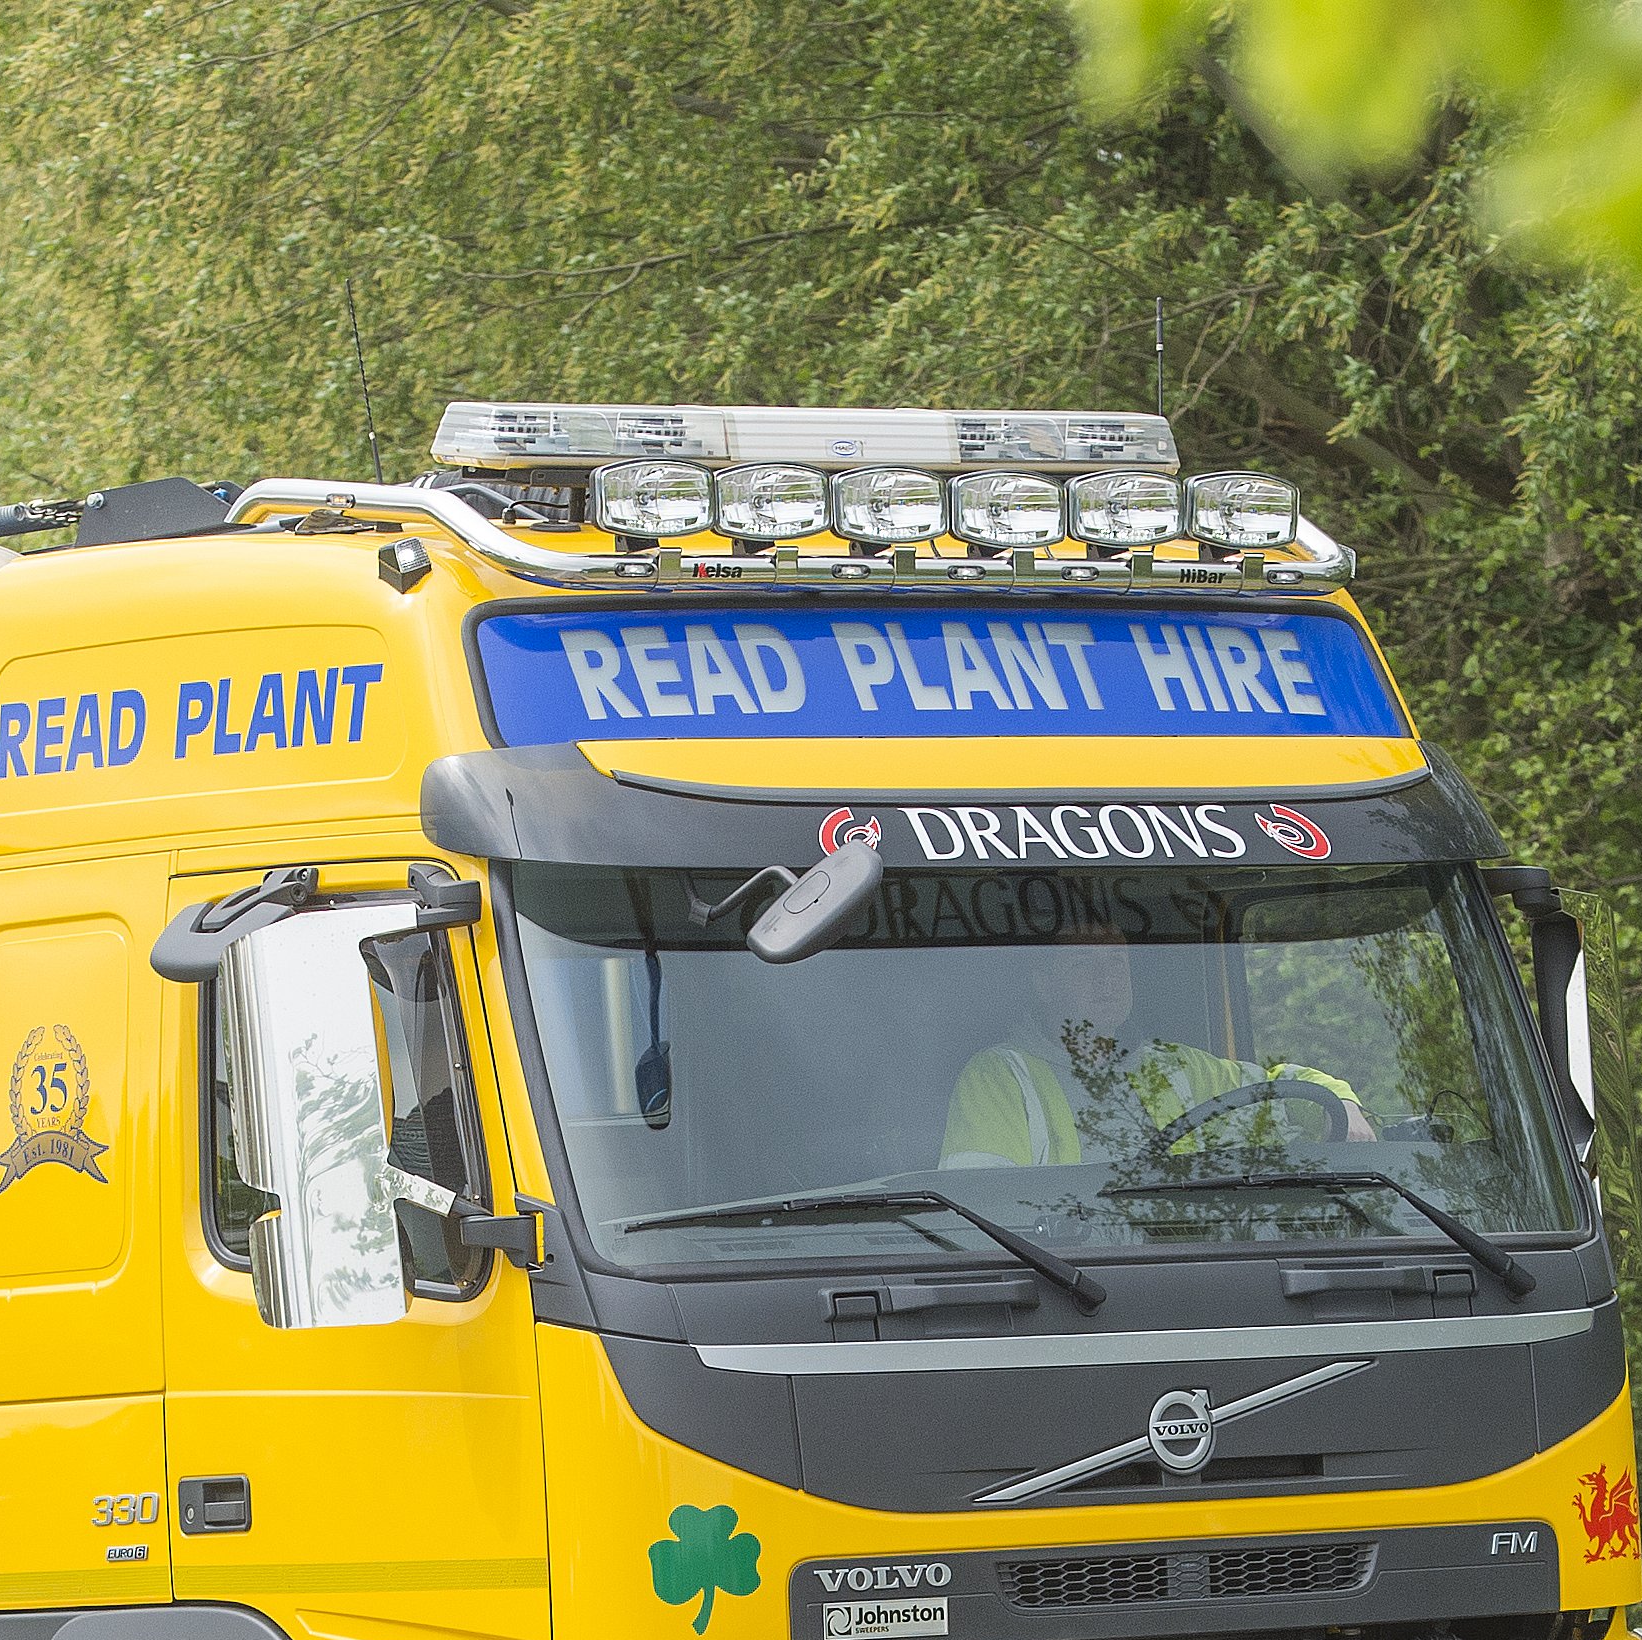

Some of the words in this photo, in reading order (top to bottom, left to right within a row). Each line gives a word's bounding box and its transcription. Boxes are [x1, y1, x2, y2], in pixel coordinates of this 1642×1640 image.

[692, 562, 743, 578] Kelsa
[1179, 568, 1226, 583] HiBar
[559, 625, 806, 720] READ
[831, 620, 1105, 713] PLANT
[1130, 624, 1327, 716] HIRE
[174, 663, 384, 760] PLANT
[897, 804, 1247, 860] DRAGONS
[30, 1063, 68, 1115] 35
[36, 1116, 61, 1129] YEARS
[23, 1143, 46, 1165] Est.
[50, 1139, 75, 1161] 1981
[1153, 1423, 1209, 1436] VOLVO
[91, 1492, 160, 1527] 330
[107, 1548, 134, 1559] EURO
[1490, 1531, 1538, 1555] FM
[813, 1562, 952, 1592] VOLVO
[855, 1605, 945, 1625] Johnston
[855, 1626, 889, 1634] SWEEPERS
